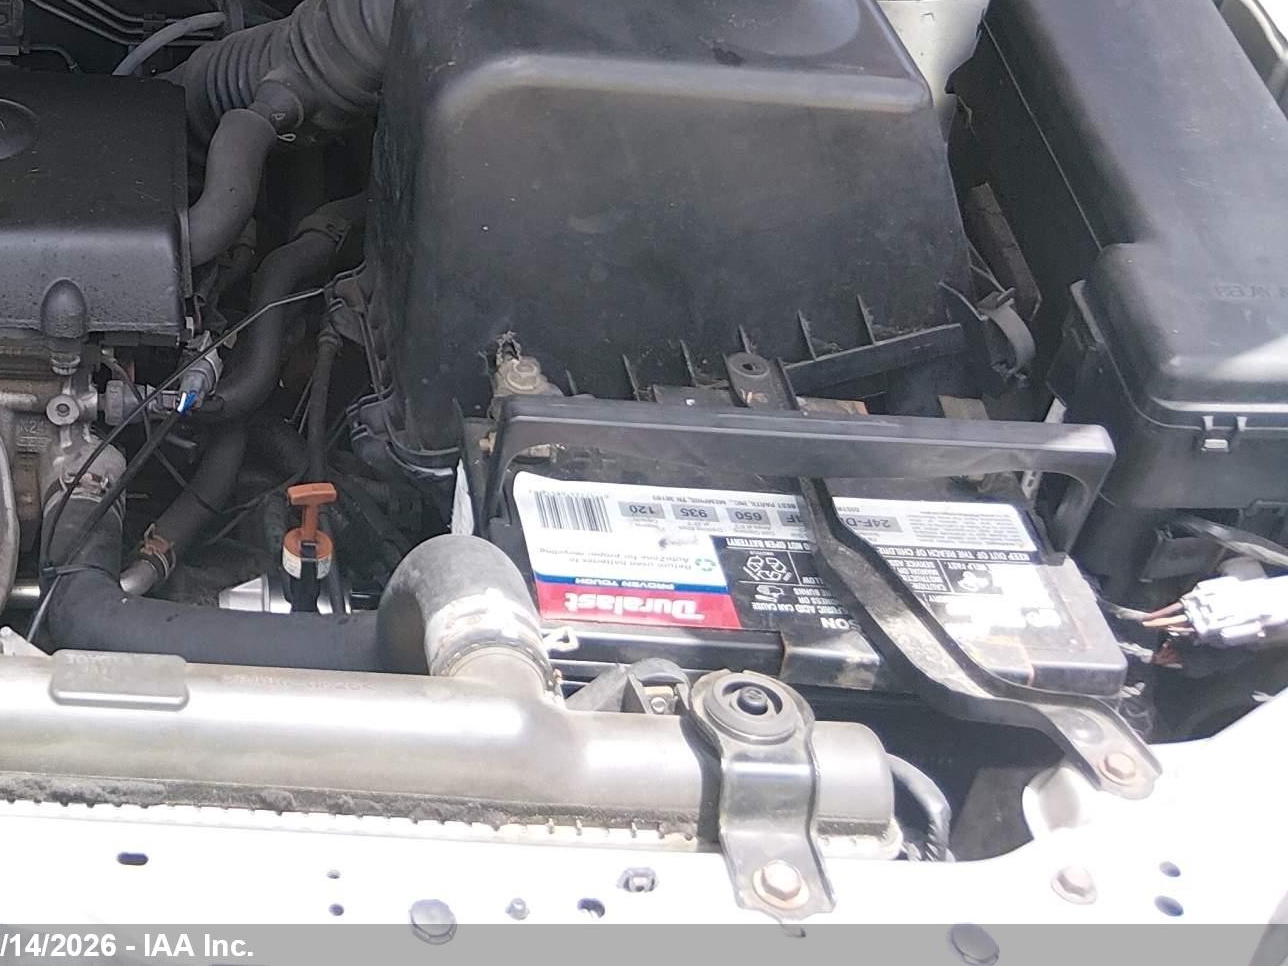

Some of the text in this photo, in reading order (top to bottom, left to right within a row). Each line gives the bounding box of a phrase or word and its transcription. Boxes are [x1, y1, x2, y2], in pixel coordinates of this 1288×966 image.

[629, 504, 655, 515] 120
[680, 507, 707, 518] 935
[735, 511, 762, 521] 650
[928, 549, 955, 557] REACH
[957, 550, 973, 558] THE
[977, 551, 988, 559] OF
[575, 577, 675, 590] PROVEN TOUGH
[564, 592, 704, 621] Duralast
[752, 602, 776, 611] CAUSE
[777, 603, 794, 612] CAN
